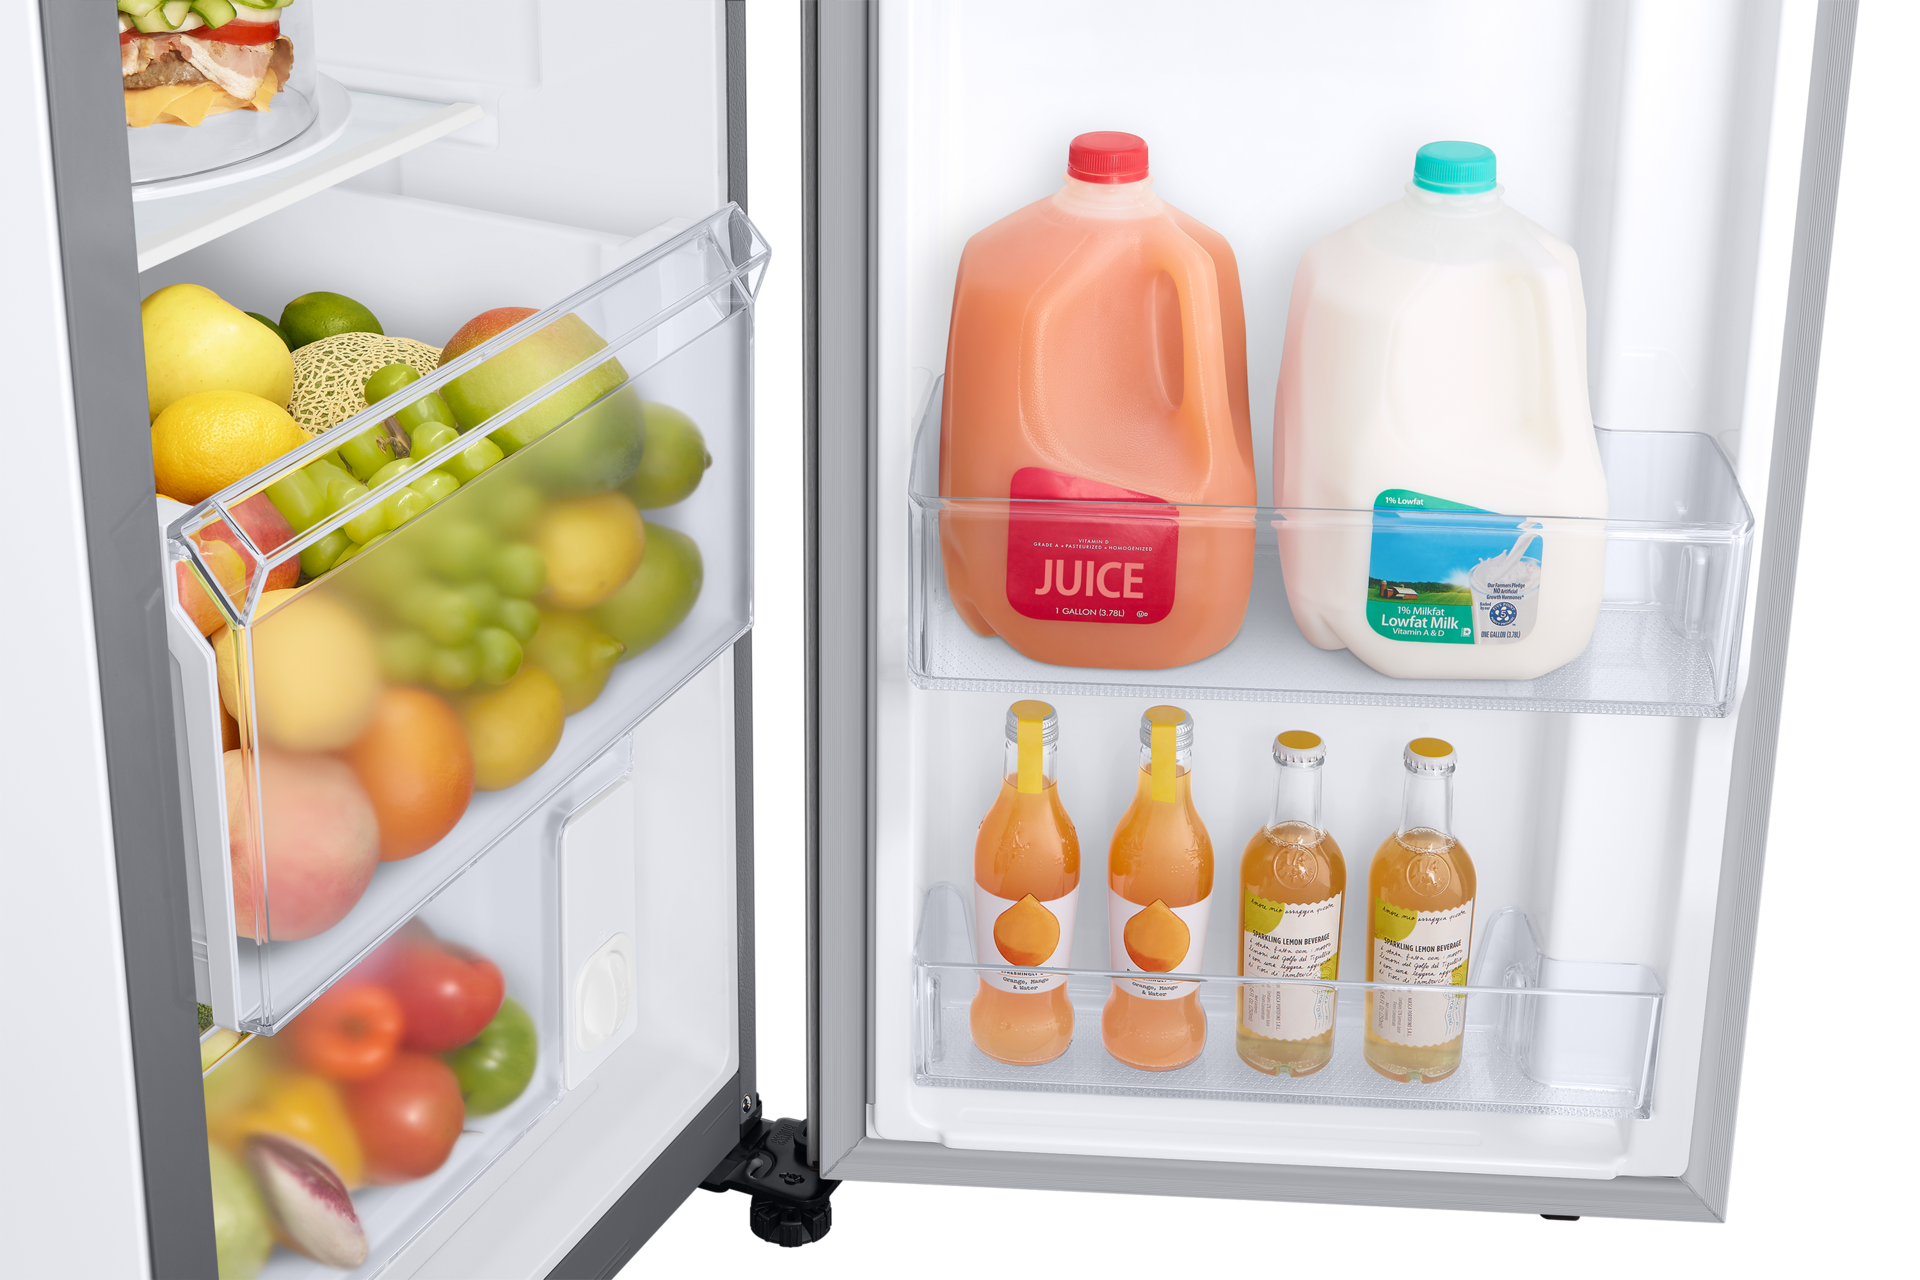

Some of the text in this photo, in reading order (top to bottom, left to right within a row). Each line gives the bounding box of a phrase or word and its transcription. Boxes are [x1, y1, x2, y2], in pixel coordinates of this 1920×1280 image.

[1035, 559, 1144, 599] JUICE
[1099, 609, 1125, 617] (3.78L)
[1413, 607, 1445, 616] Milkfat
[1382, 614, 1459, 629] Lowfat Milk
[1253, 930, 1281, 944] SPARKLING
[1304, 933, 1330, 945] BEVERAGE
[1384, 937, 1413, 952] SPARKLING
[1437, 939, 1462, 952] BEVERAGE
[1003, 977, 1027, 985] Orange,
[1132, 982, 1156, 990] Orange,
